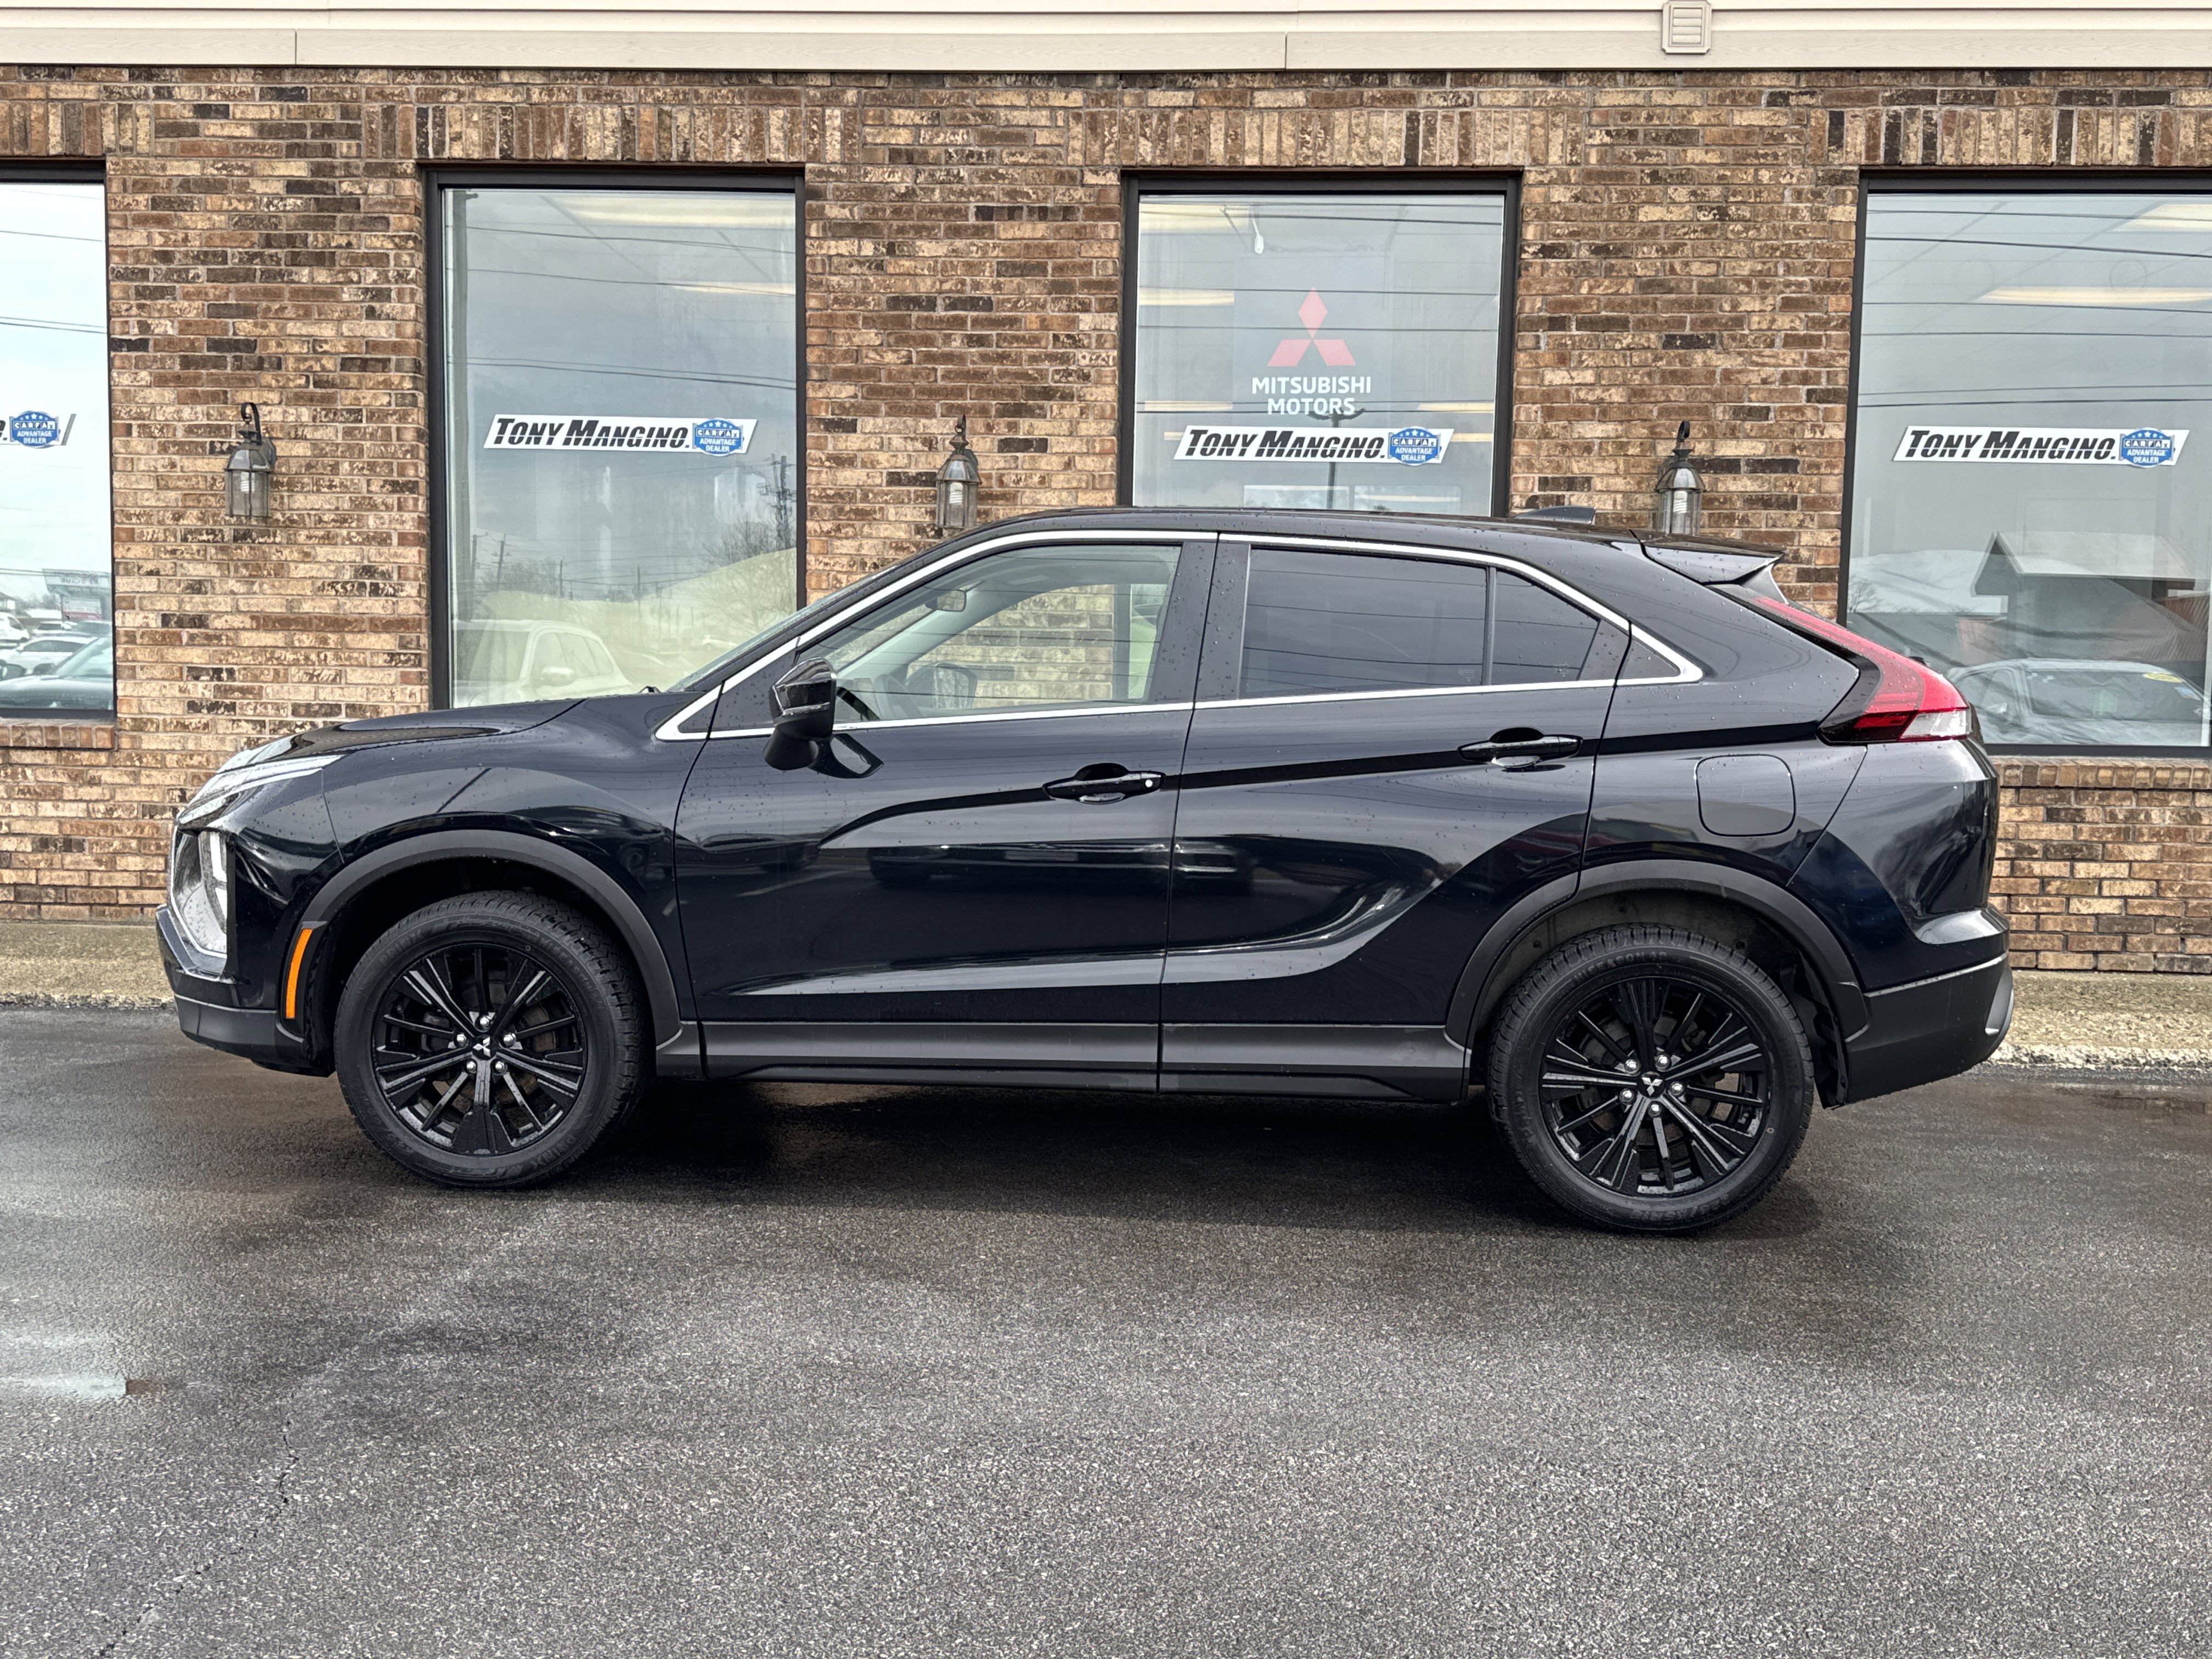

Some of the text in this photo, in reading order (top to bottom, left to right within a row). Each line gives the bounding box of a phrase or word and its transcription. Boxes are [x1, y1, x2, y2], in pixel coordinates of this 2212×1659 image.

[1251, 376, 1372, 394] MITSUBISHI
[1267, 397, 1355, 415] MOTORS
[14, 421, 55, 430] CARFAX
[493, 418, 690, 448] TONY MANGINO.
[697, 428, 740, 438] CARFAX
[699, 438, 736, 446] ADVANTAGE
[1184, 429, 1385, 459] TONY MANGINO.
[1392, 438, 1436, 447] CARFAX
[1905, 430, 2116, 460] TONY MANGINO.
[2124, 439, 2170, 448] CARFAX
